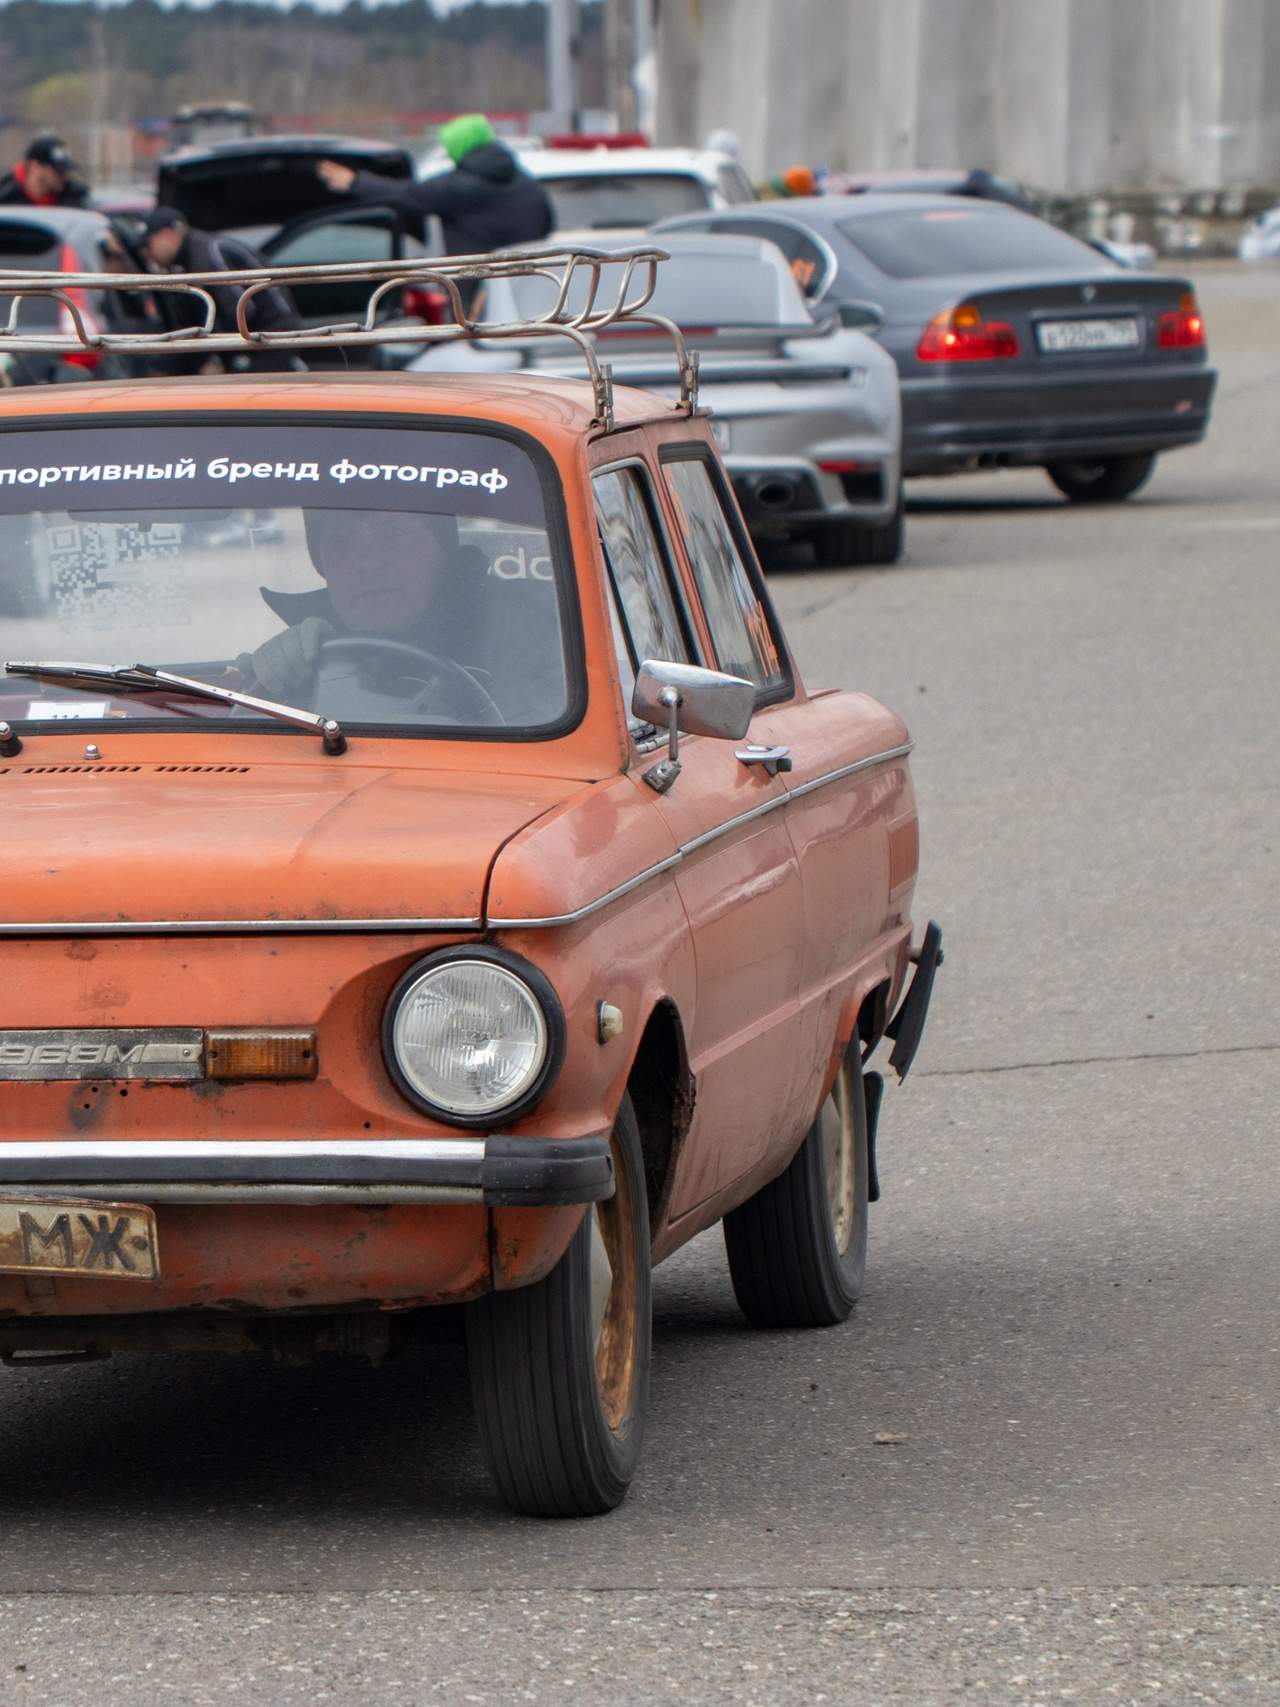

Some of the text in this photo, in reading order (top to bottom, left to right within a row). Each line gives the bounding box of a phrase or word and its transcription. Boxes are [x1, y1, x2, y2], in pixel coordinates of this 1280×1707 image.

[207, 457, 320, 483] бренд
[329, 458, 509, 494] фотограф
[19, 1210, 137, 1272] МЖ
